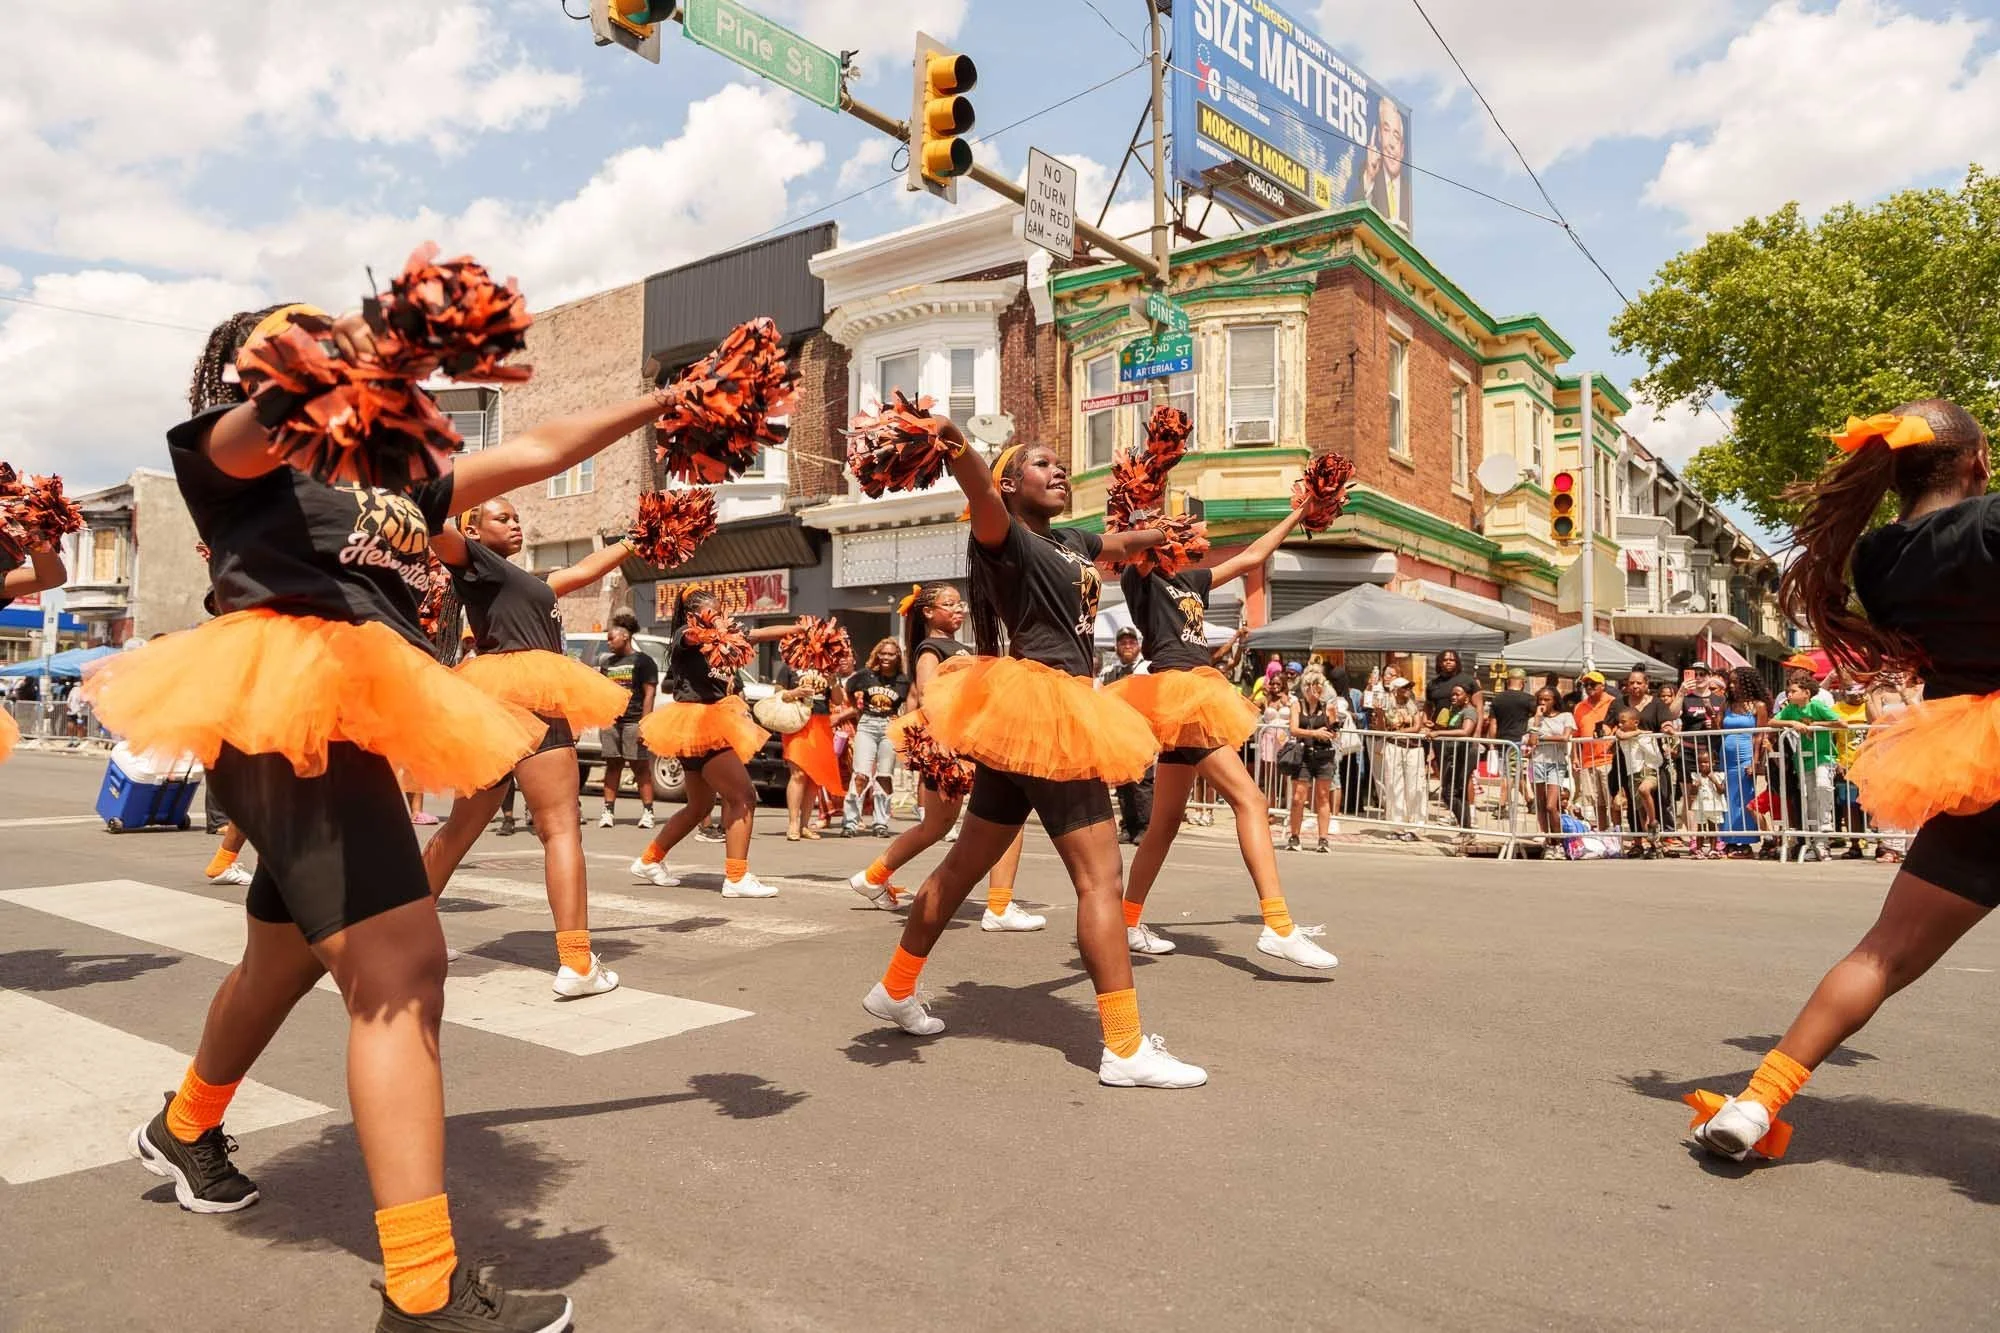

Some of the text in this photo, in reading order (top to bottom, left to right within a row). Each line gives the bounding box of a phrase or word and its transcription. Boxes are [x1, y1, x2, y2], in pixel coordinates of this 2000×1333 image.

[716, 7, 814, 83] Pine St
[1195, 0, 1254, 71] SIZE
[1259, 20, 1368, 147] MATTERS
[1202, 107, 1250, 159] MORGAN
[1252, 139, 1261, 165] &
[1262, 144, 1306, 191] MORGAN
[1044, 162, 1061, 183] NO
[1039, 181, 1067, 207] TURN
[1248, 171, 1285, 207] 094096
[1030, 199, 1070, 229] ON RED
[1028, 219, 1044, 239] 6AM
[1055, 232, 1071, 248] 6PM
[1150, 300, 1175, 326] PINE
[1178, 319, 1187, 331] ST
[1135, 343, 1191, 364] 52ND ST
[1123, 359, 1189, 380] N ARTERIAL S
[1121, 393, 1132, 405] Ali
